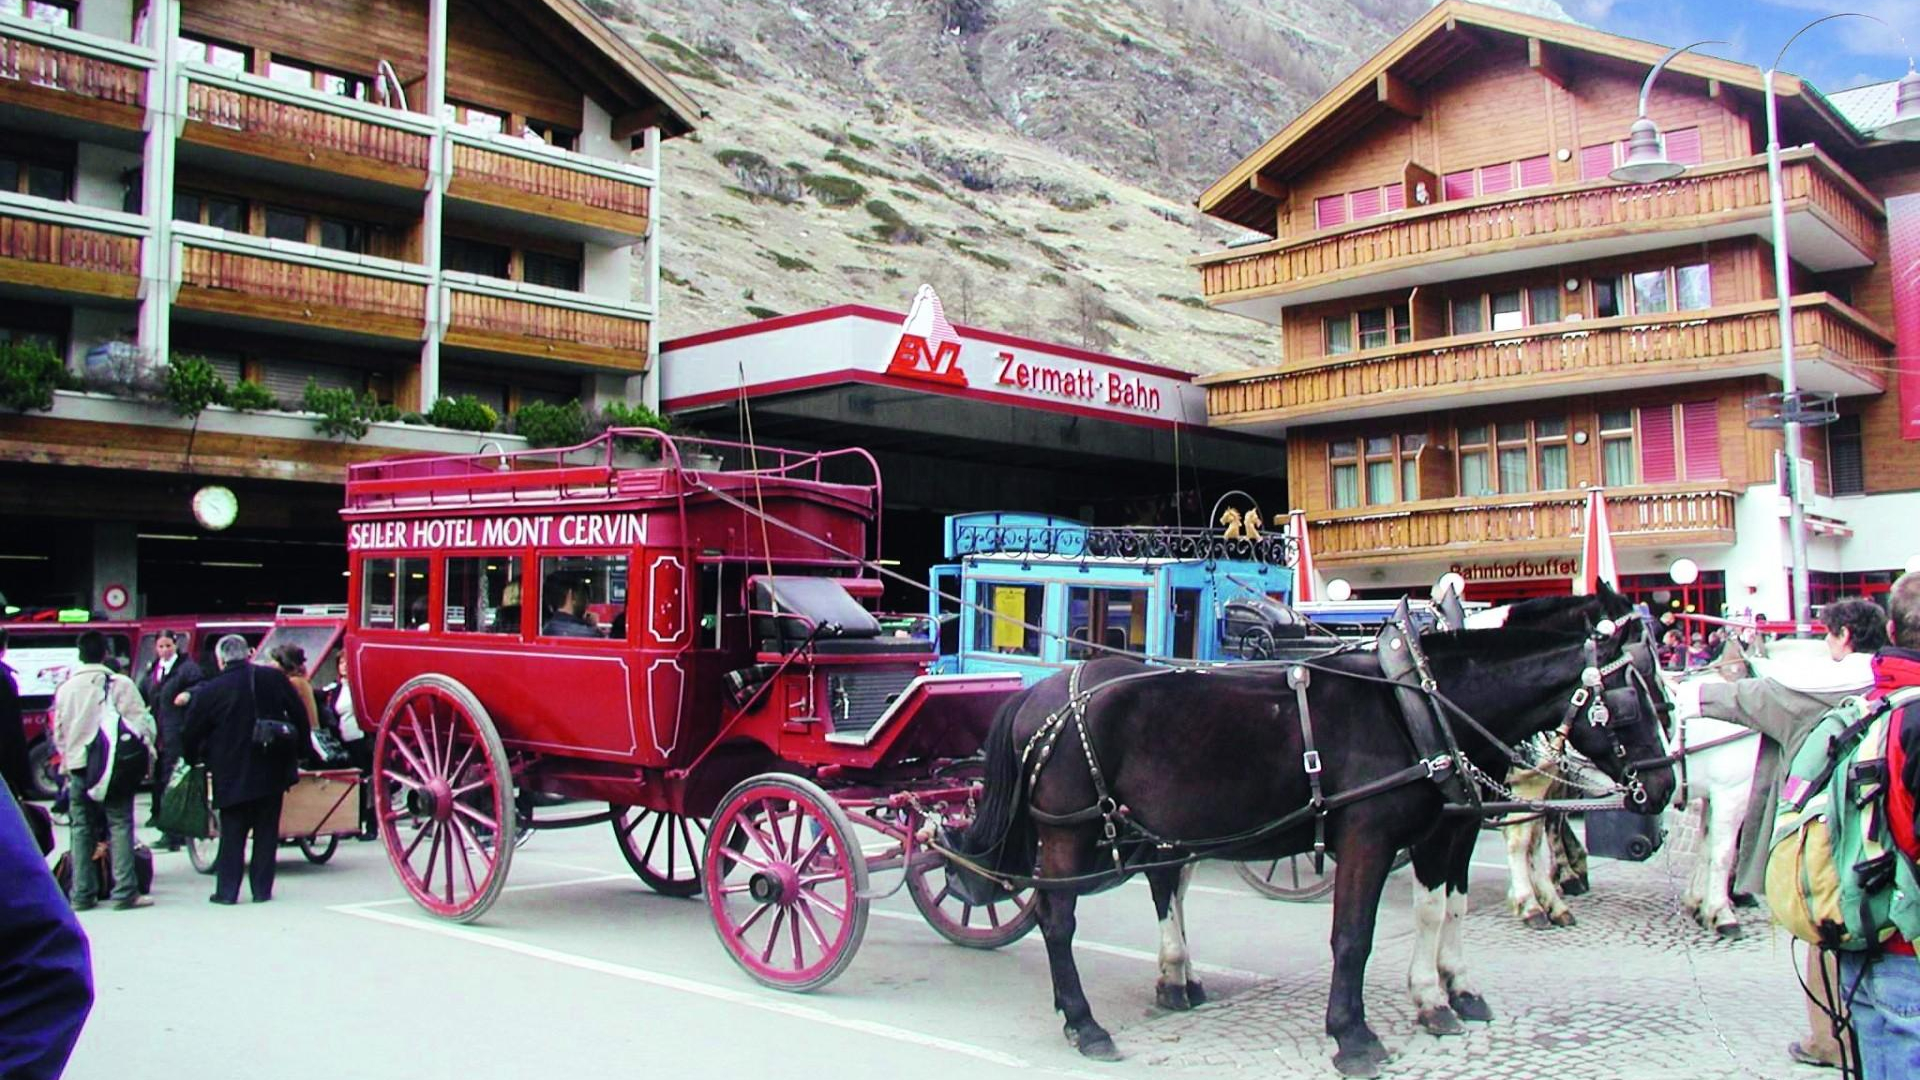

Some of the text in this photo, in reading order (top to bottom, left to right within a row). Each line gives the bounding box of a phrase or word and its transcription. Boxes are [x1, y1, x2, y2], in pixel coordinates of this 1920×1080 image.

[886, 333, 968, 387] BVZ
[350, 513, 648, 549] SEILER HOTEL MONT CERVIN
